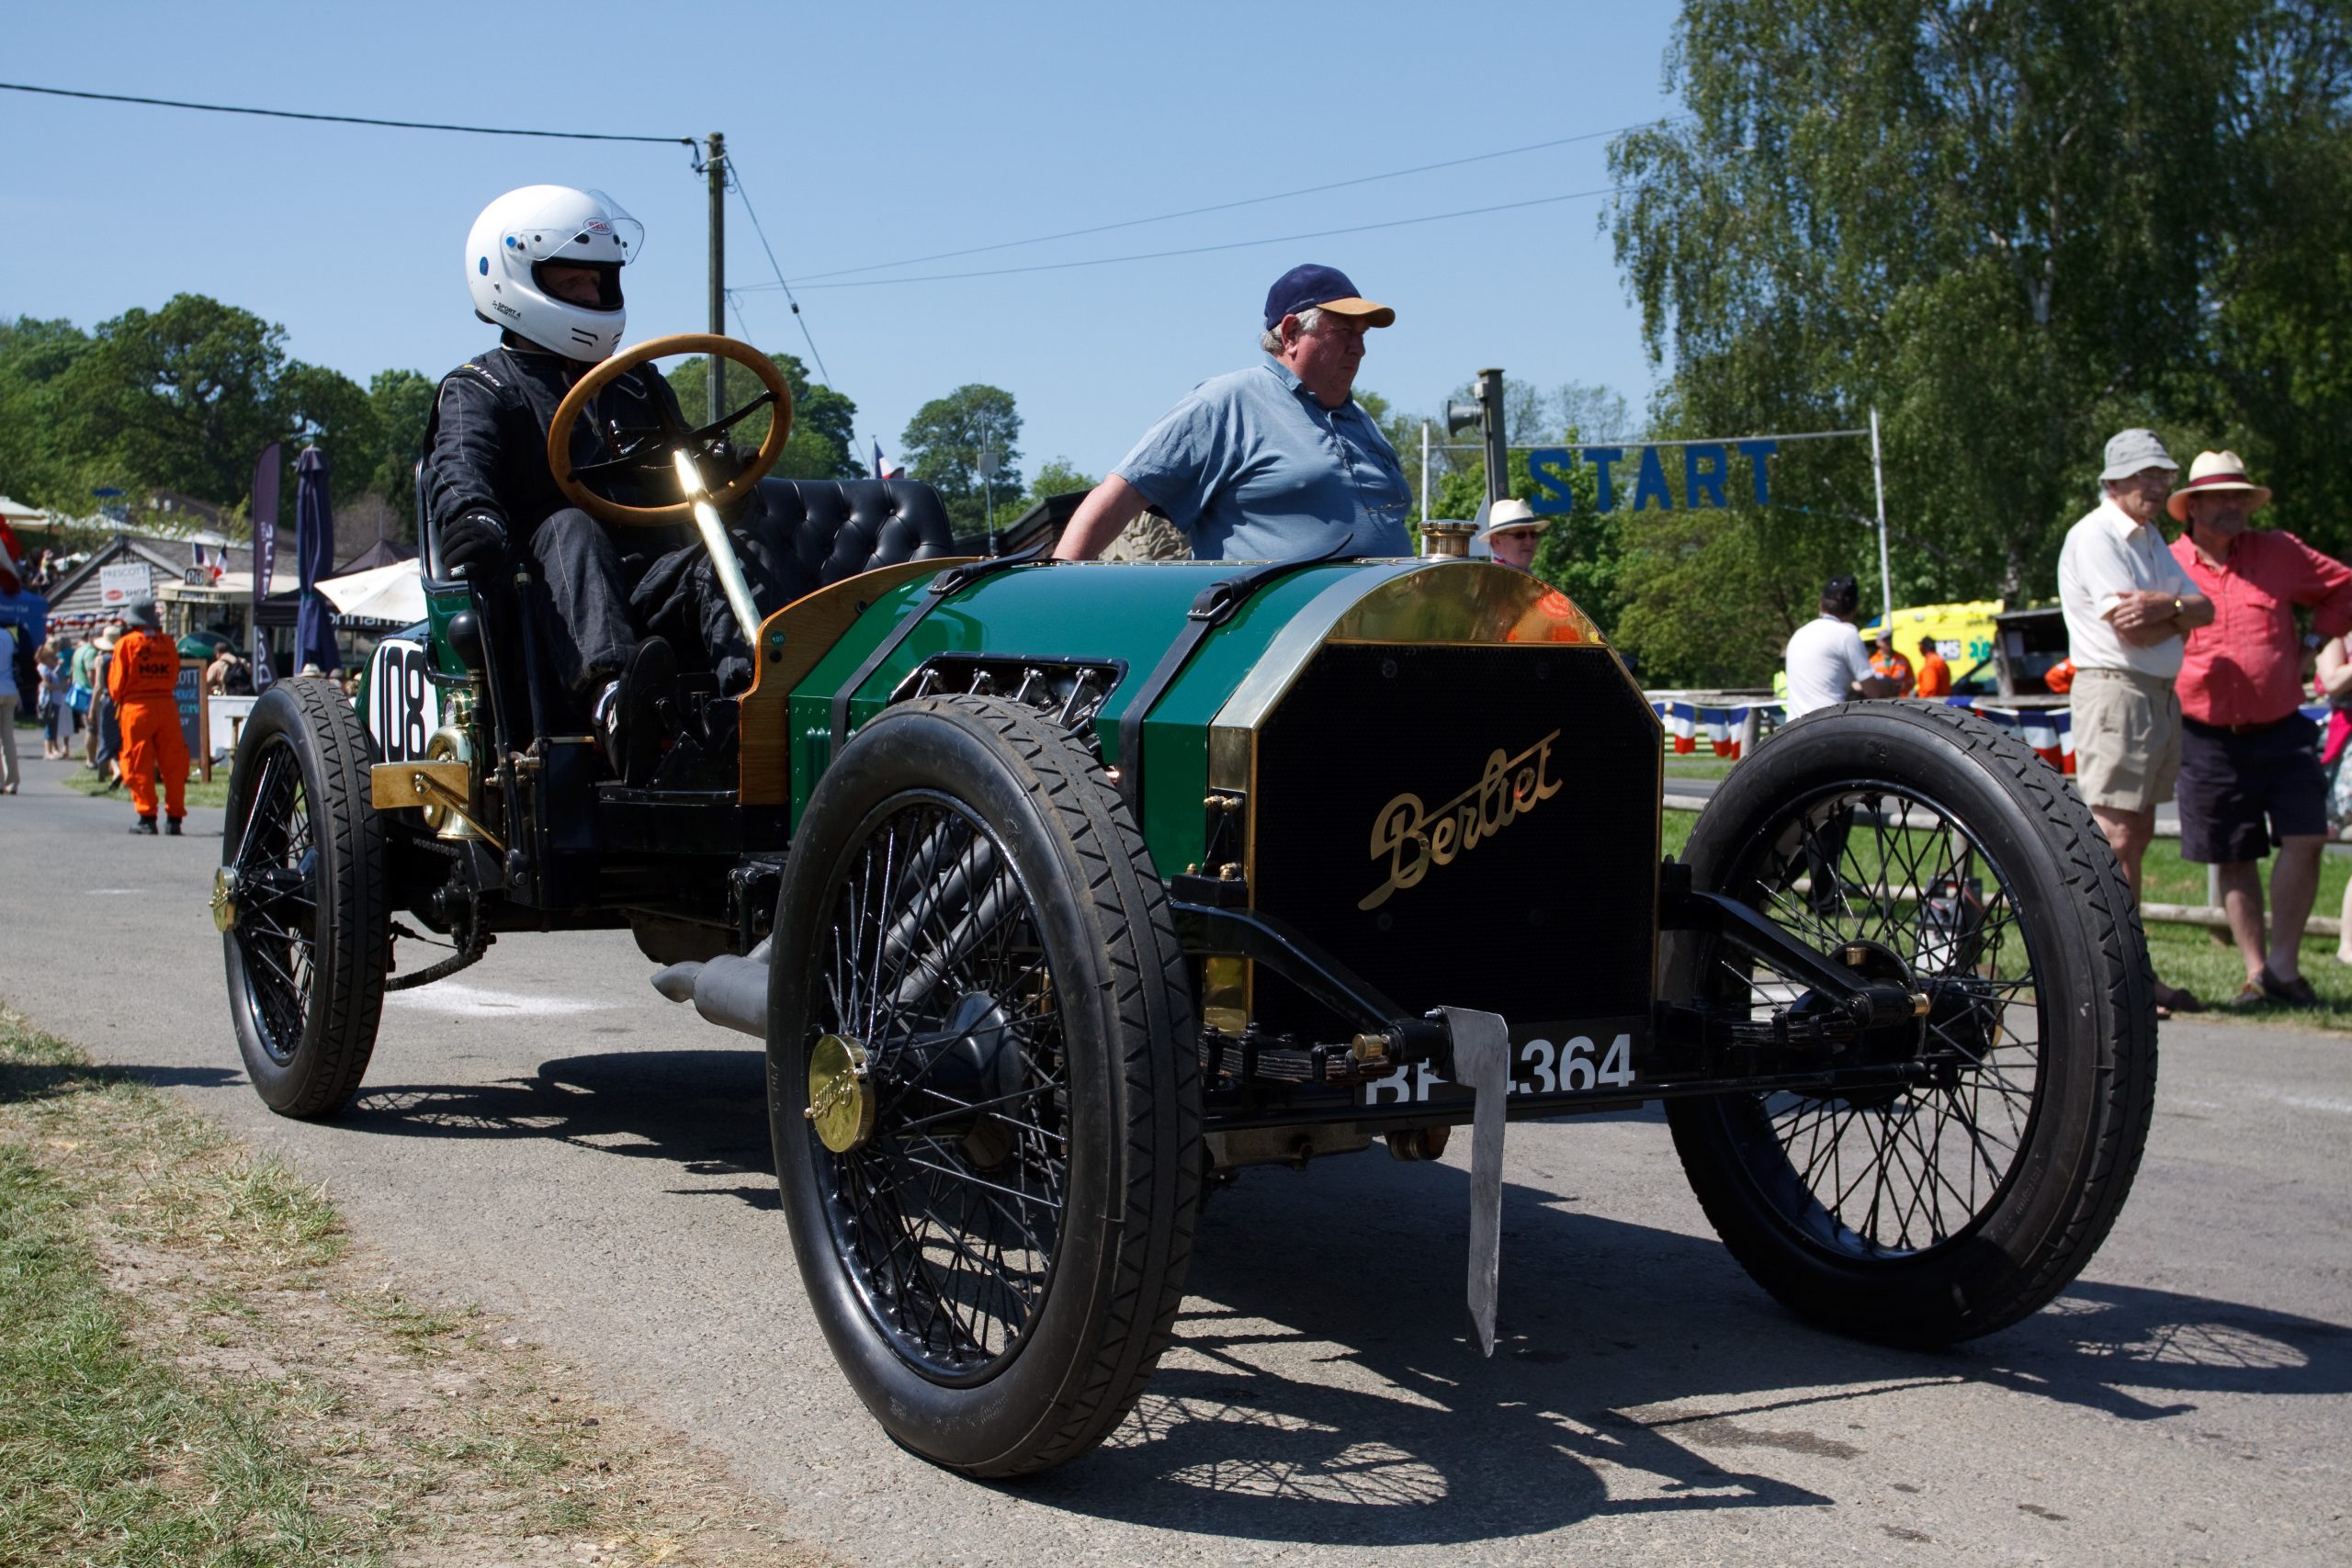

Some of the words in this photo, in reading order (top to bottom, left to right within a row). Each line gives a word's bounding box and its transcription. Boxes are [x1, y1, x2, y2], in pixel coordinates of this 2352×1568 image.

[588, 221, 611, 231] BELL
[497, 302, 516, 315] SPORT
[1529, 440, 1777, 515] START
[102, 565, 147, 579] PRESCOTT
[124, 589, 148, 597] SHOP
[139, 663, 169, 675] NGK
[379, 646, 425, 761] 108
[1358, 728, 1562, 910] Berliet
